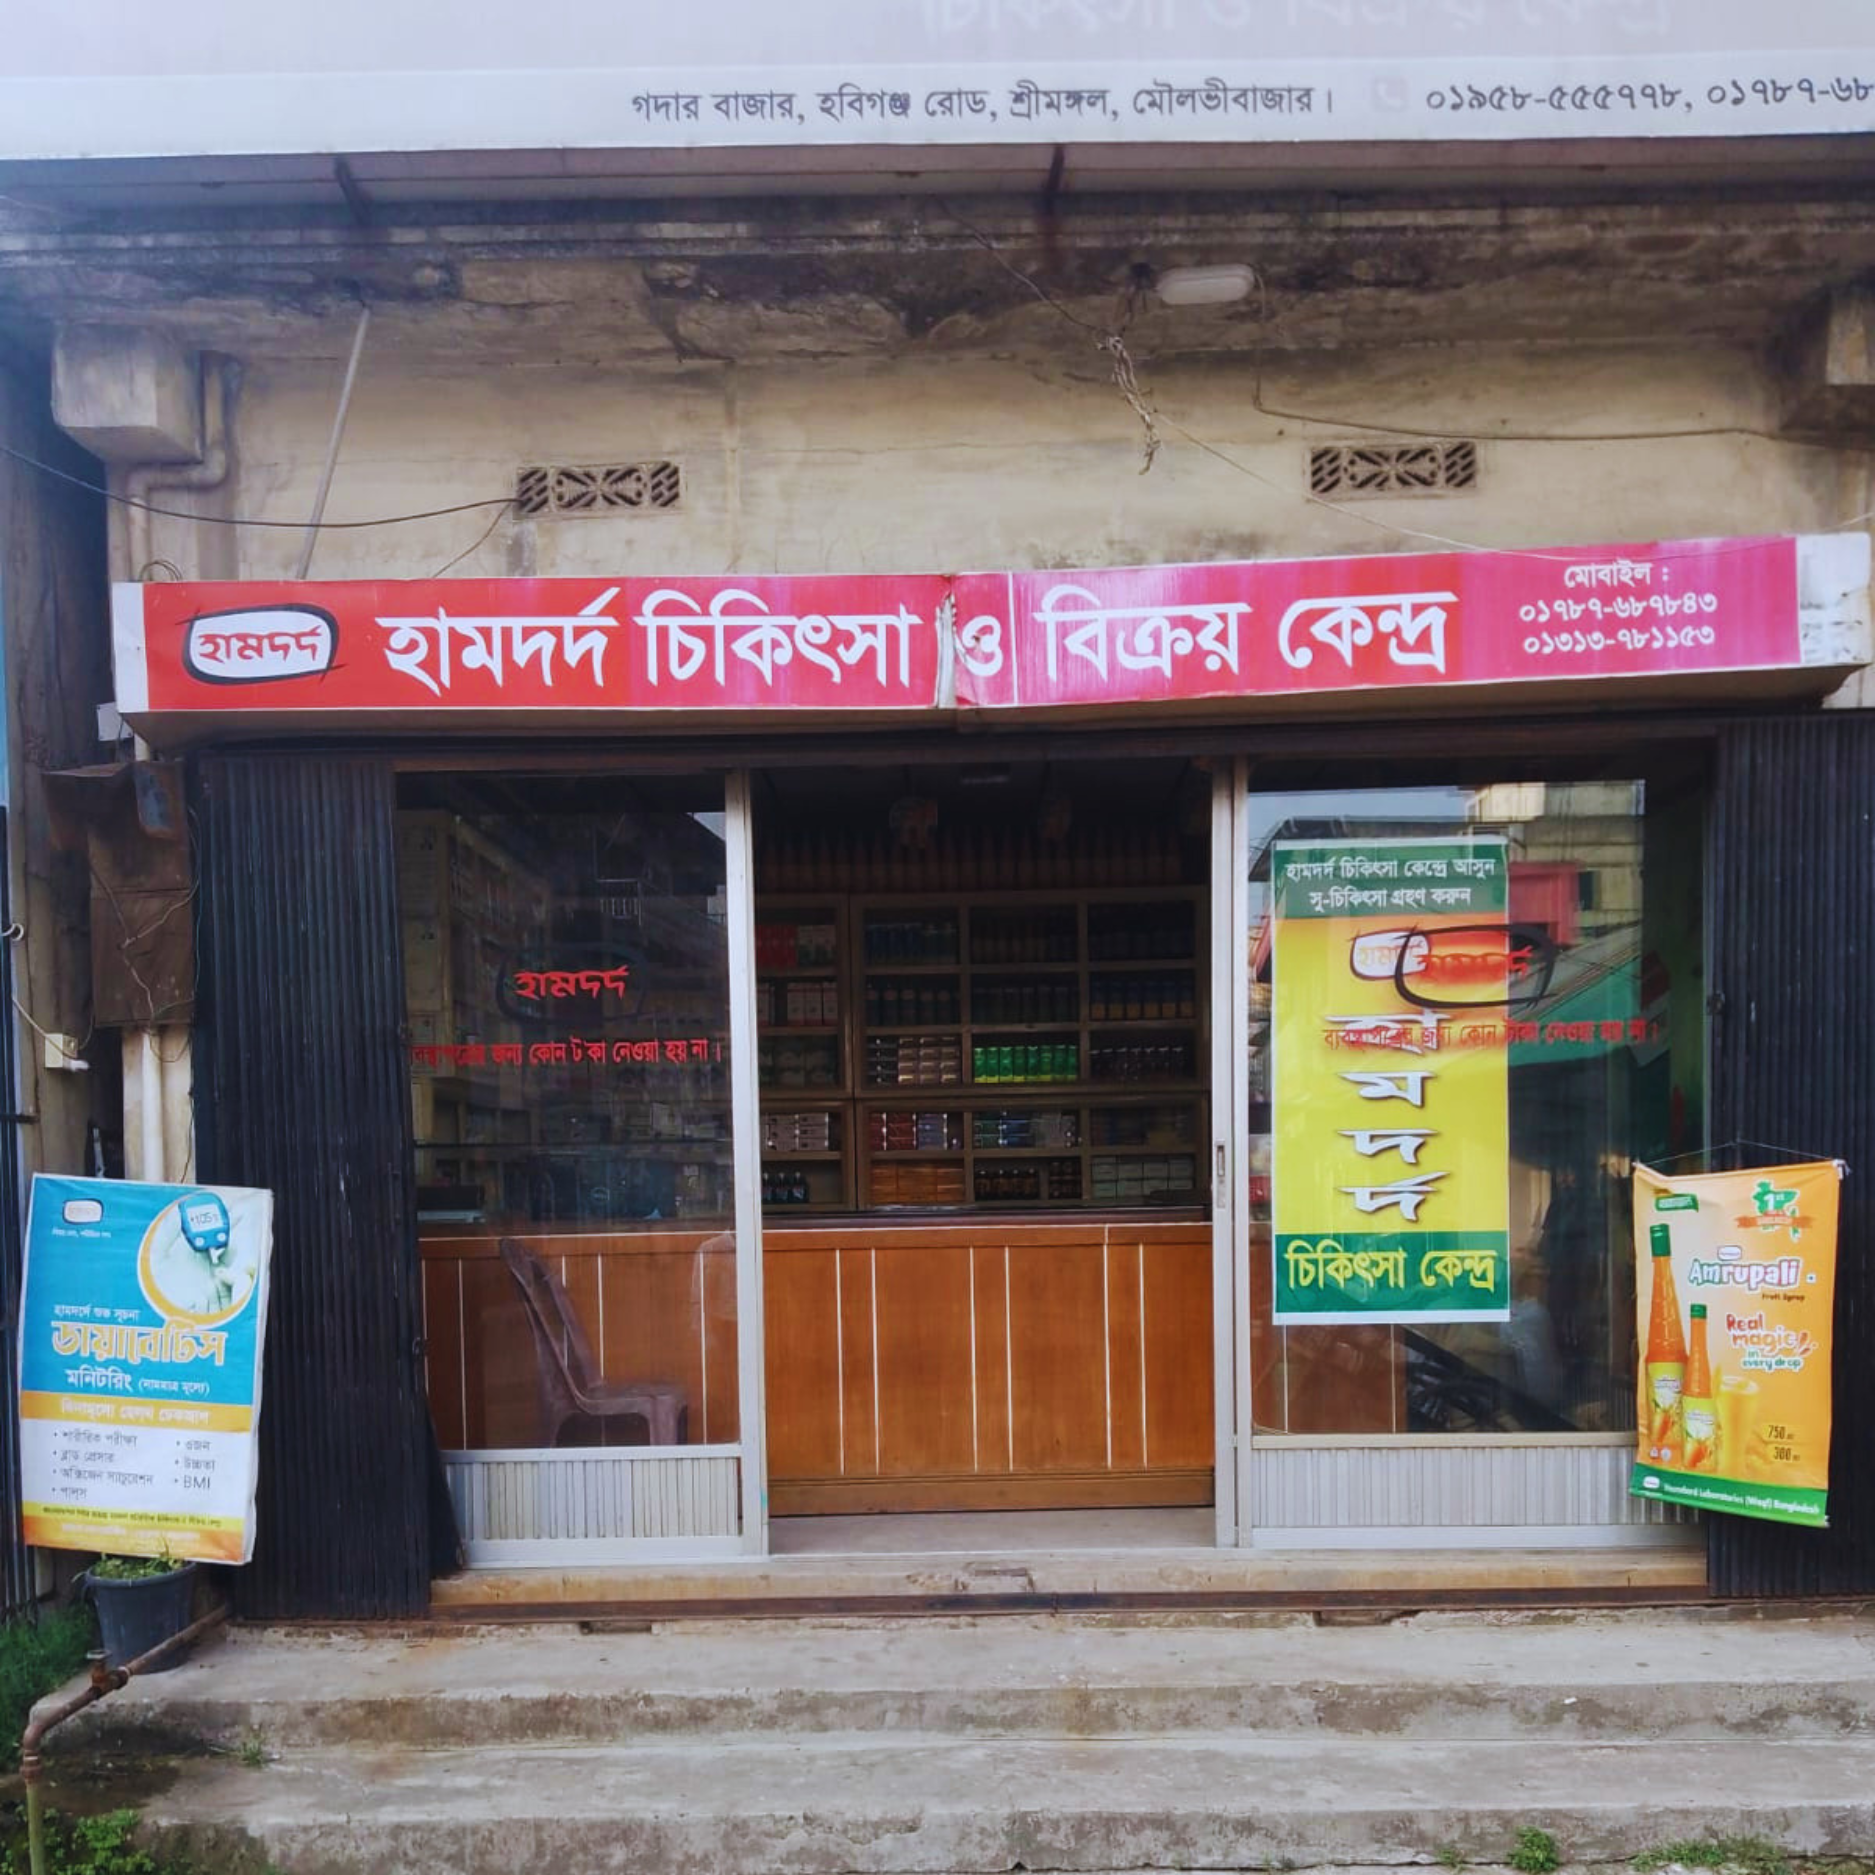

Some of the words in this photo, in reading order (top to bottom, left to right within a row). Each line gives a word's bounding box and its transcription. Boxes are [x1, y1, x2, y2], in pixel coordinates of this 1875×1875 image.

[631, 91, 703, 123] গদার
[711, 91, 806, 125] বাজার,
[816, 83, 912, 121] হবিগঞ্জ
[924, 89, 999, 124] রোড,
[1008, 79, 1120, 122] শ্রীমঙ্গল,
[1131, 76, 1315, 117] মৌলভীবাজার
[1426, 84, 1694, 112] ০১৯৫৮-৫৫৫৭৭৮,
[1563, 558, 1654, 588] মোবাইল
[1519, 592, 1718, 623] ০১৭৮৭-৬৮৭৮৪৩
[197, 624, 323, 664] হামদর্দ
[375, 586, 621, 698] হামদর্দ
[632, 588, 924, 687] চিকিৎসা
[955, 614, 1001, 677] ও
[1033, 584, 1253, 683] বিক্রয়
[1278, 591, 1460, 675] কেন্দ্র
[1523, 625, 1716, 654] ০১৩১৩-৭৮১১৫৩
[513, 965, 629, 1000] হামদর্দ
[1285, 1239, 1408, 1290] চিকিৎসা
[1420, 1250, 1499, 1294] কেন্দ্র
[1689, 1259, 1800, 1291] Amrupali
[1726, 1313, 1763, 1331] Real
[51, 1316, 229, 1366] ডায়াবেটিস
[1743, 1359, 1773, 1371] every
[183, 1475, 211, 1489] BMI
